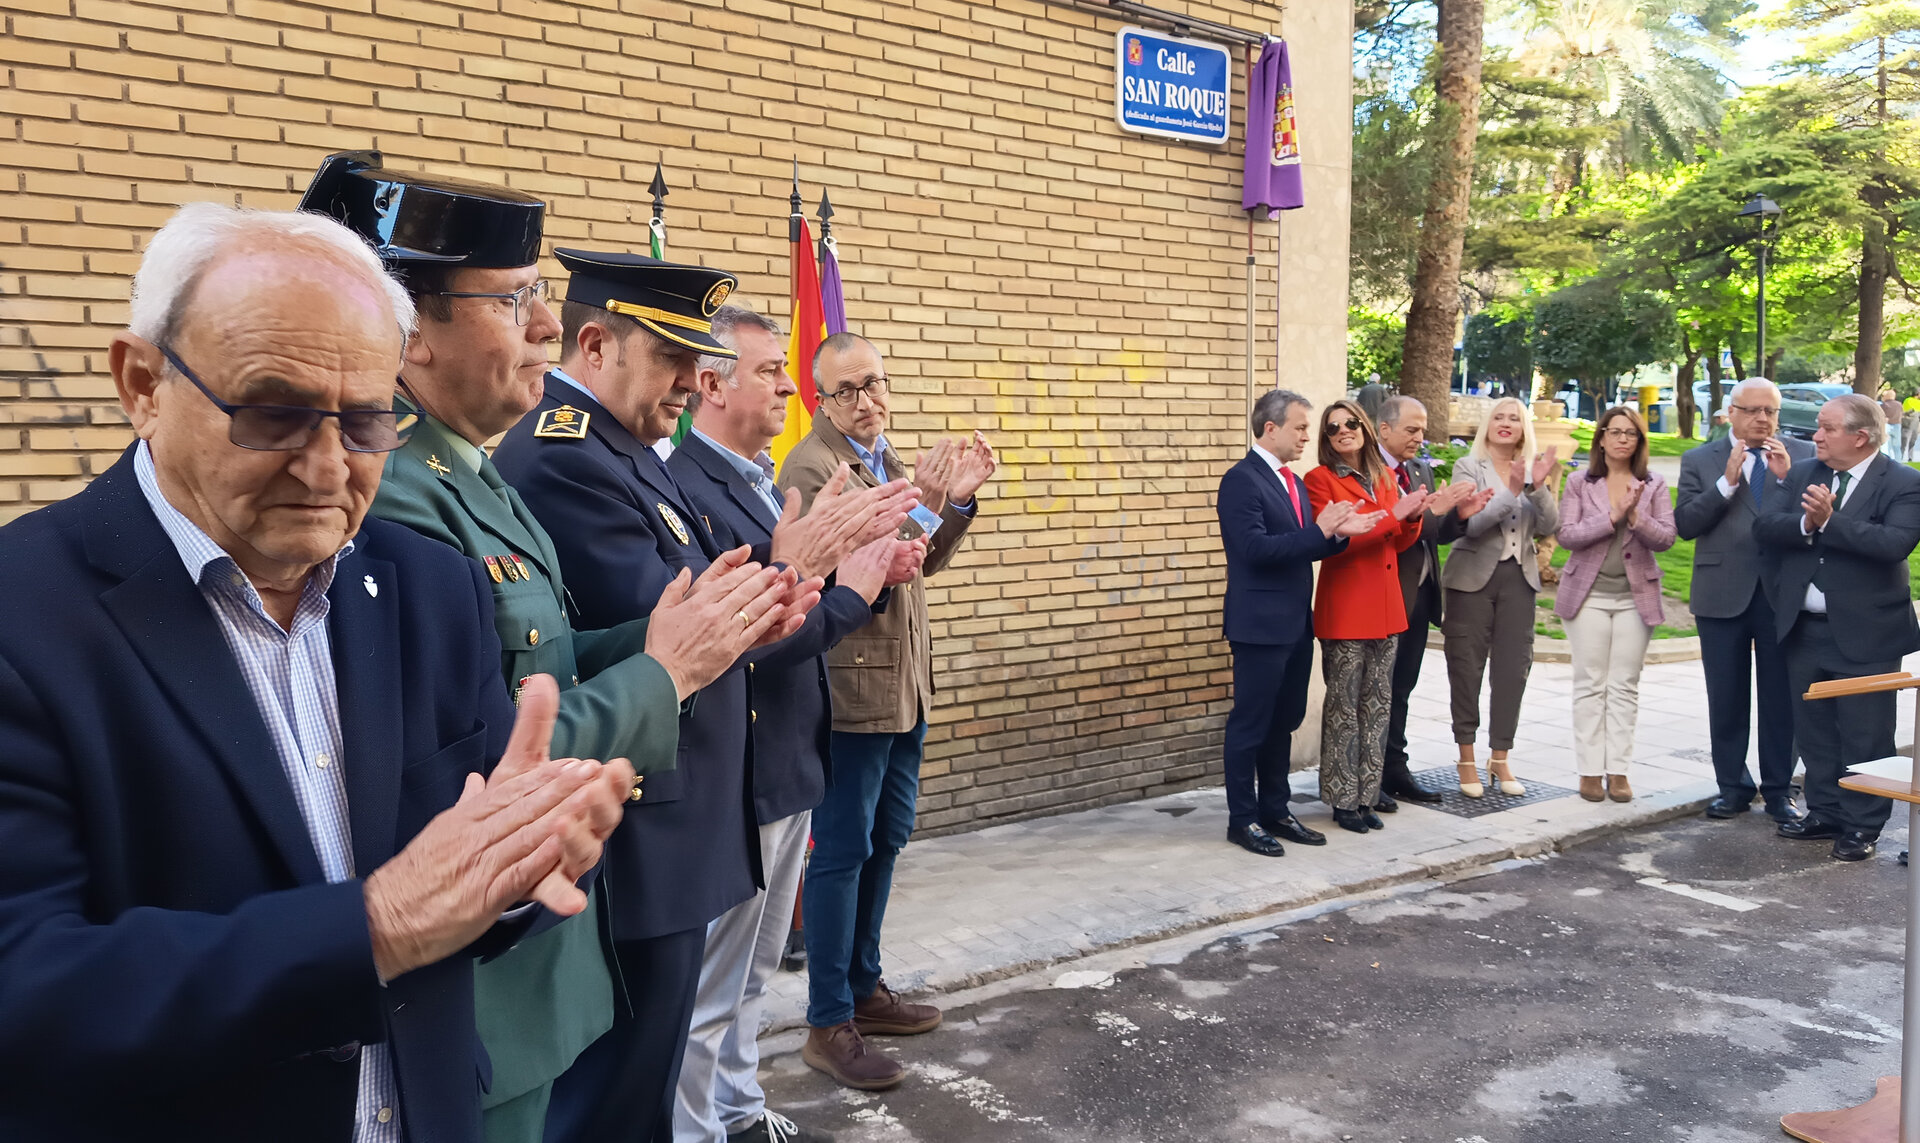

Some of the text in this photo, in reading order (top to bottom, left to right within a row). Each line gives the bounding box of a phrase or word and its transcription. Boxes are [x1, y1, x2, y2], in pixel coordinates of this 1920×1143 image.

[1157, 48, 1195, 75] Calle
[1125, 75, 1224, 118] SAN ROQUE
